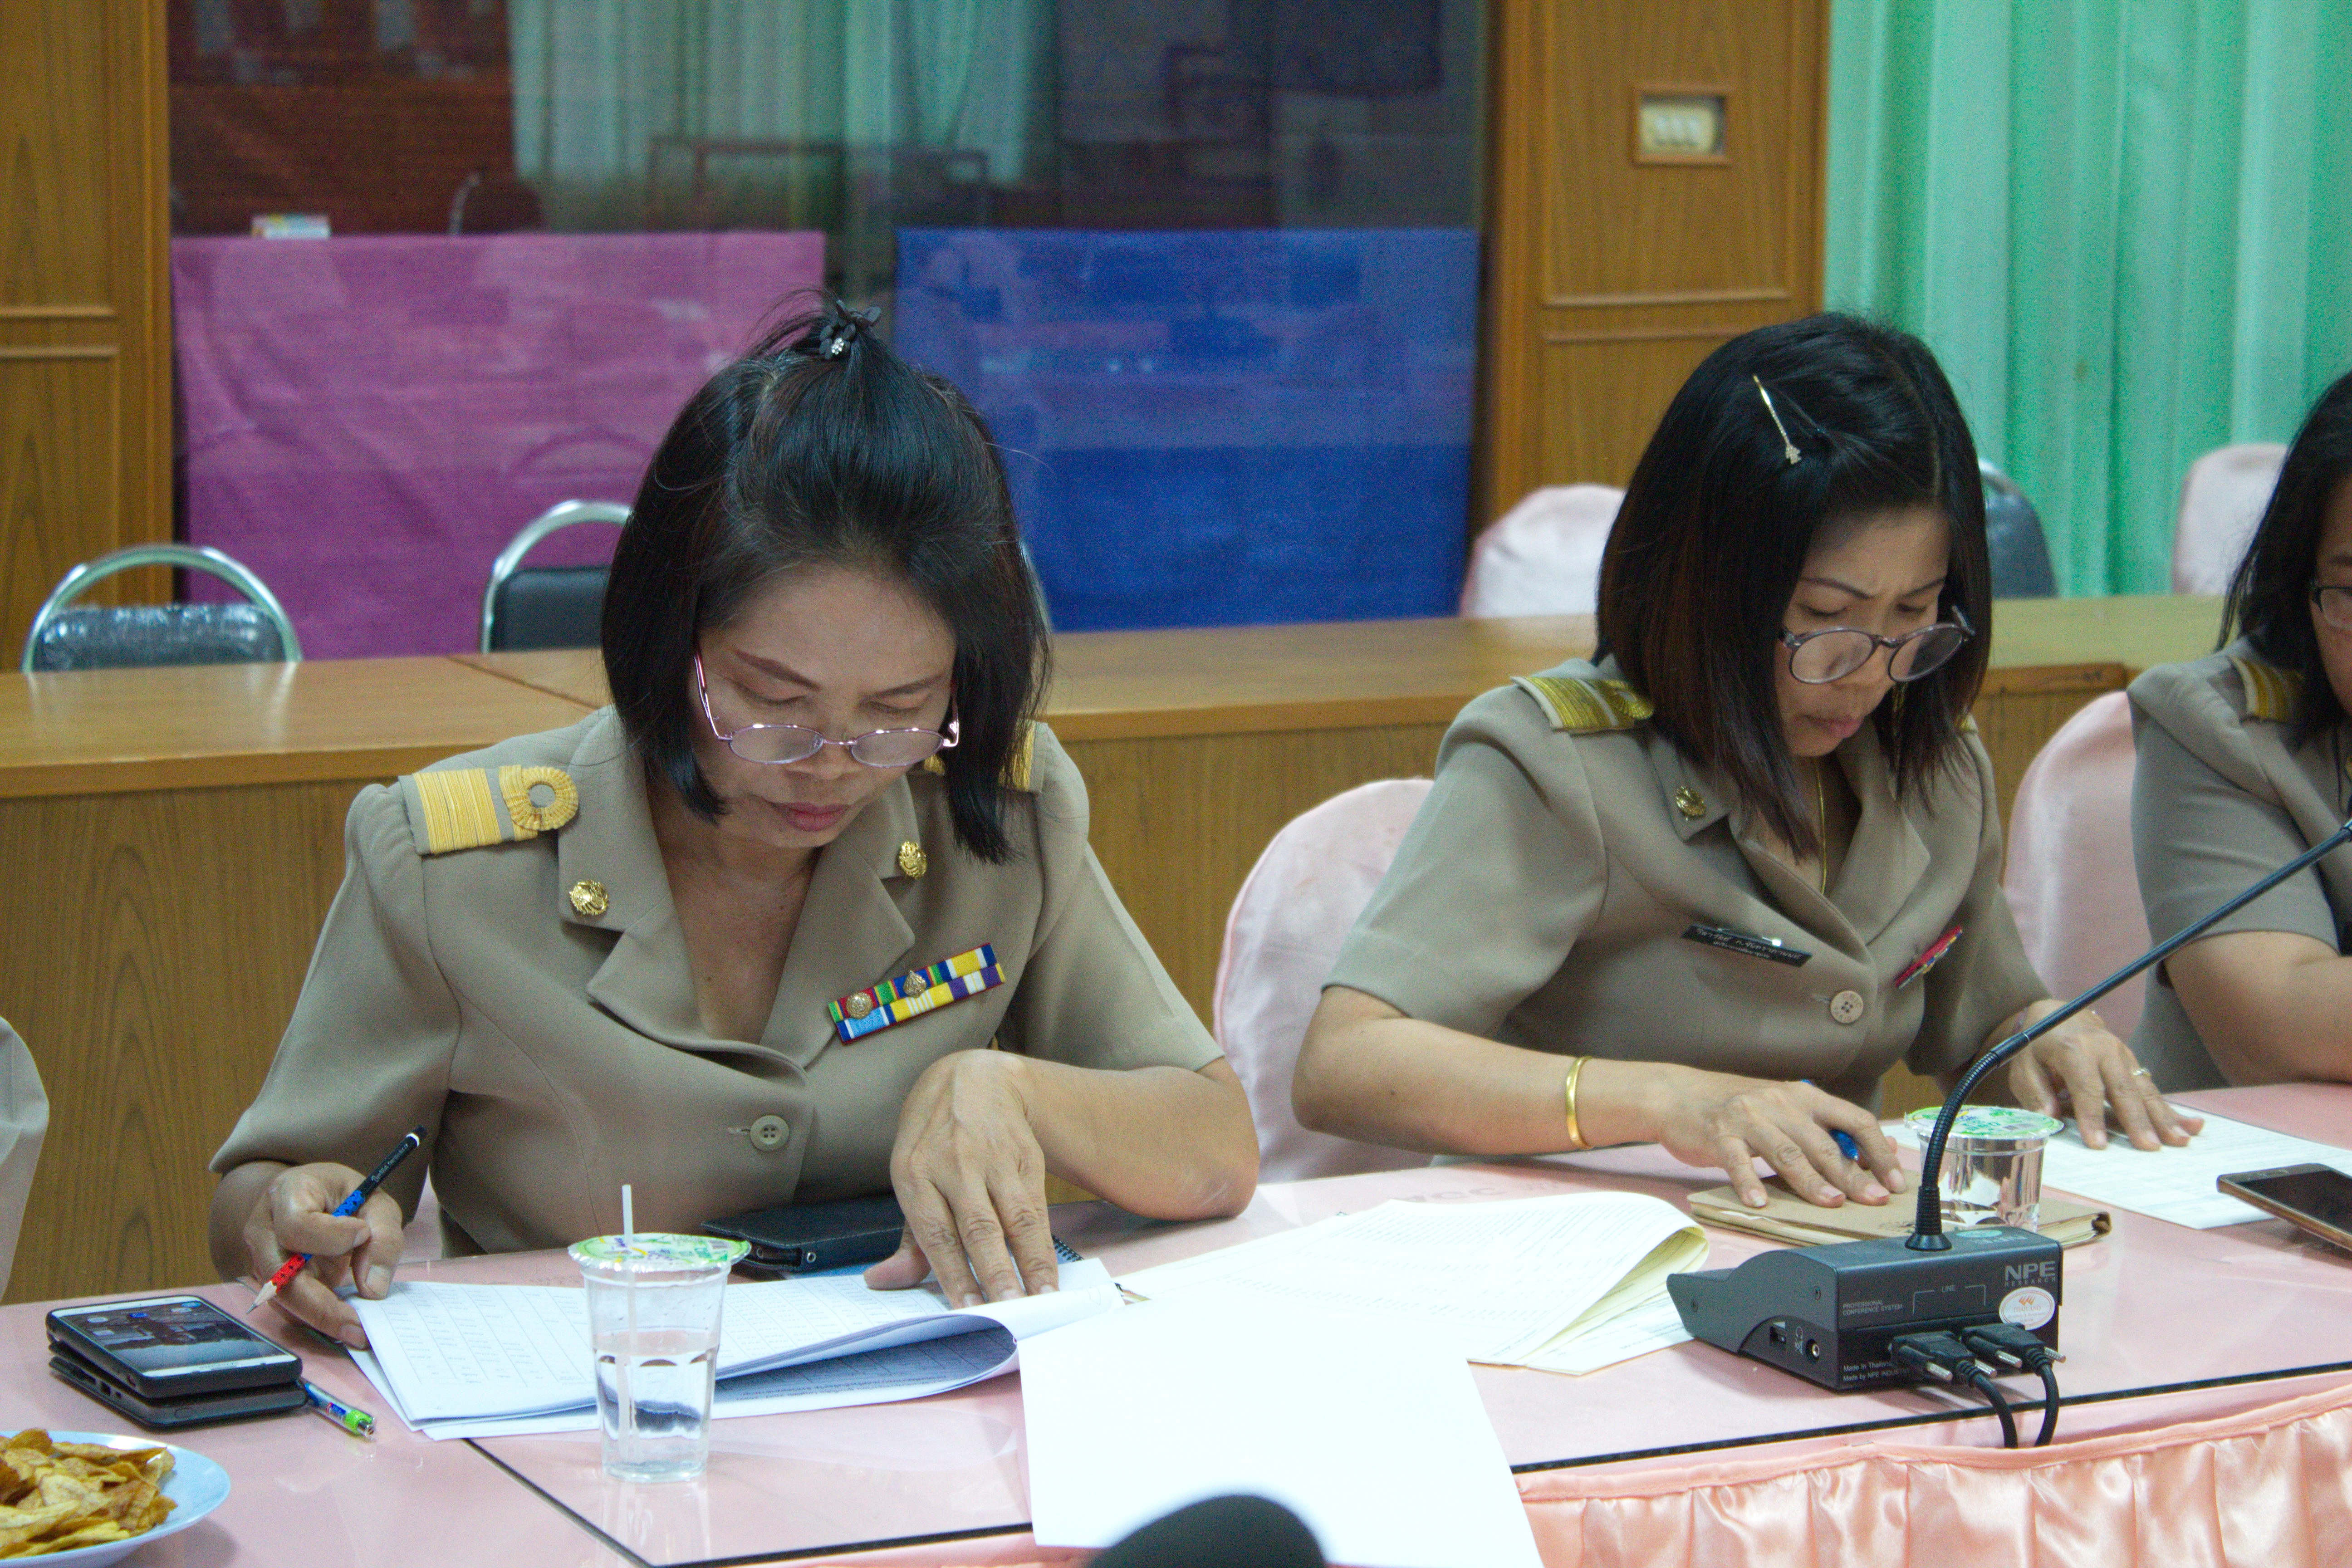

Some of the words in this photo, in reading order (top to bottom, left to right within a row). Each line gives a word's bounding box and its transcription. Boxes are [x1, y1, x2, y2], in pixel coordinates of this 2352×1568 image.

[2004, 1261, 2056, 1281] NPE
[2004, 1277, 2056, 1287] RESEARCH
[1842, 1299, 1883, 1309] PROFESSIONAL
[1842, 1306, 1879, 1316] CONFERENCE
[1881, 1303, 1903, 1312] SYSTEM
